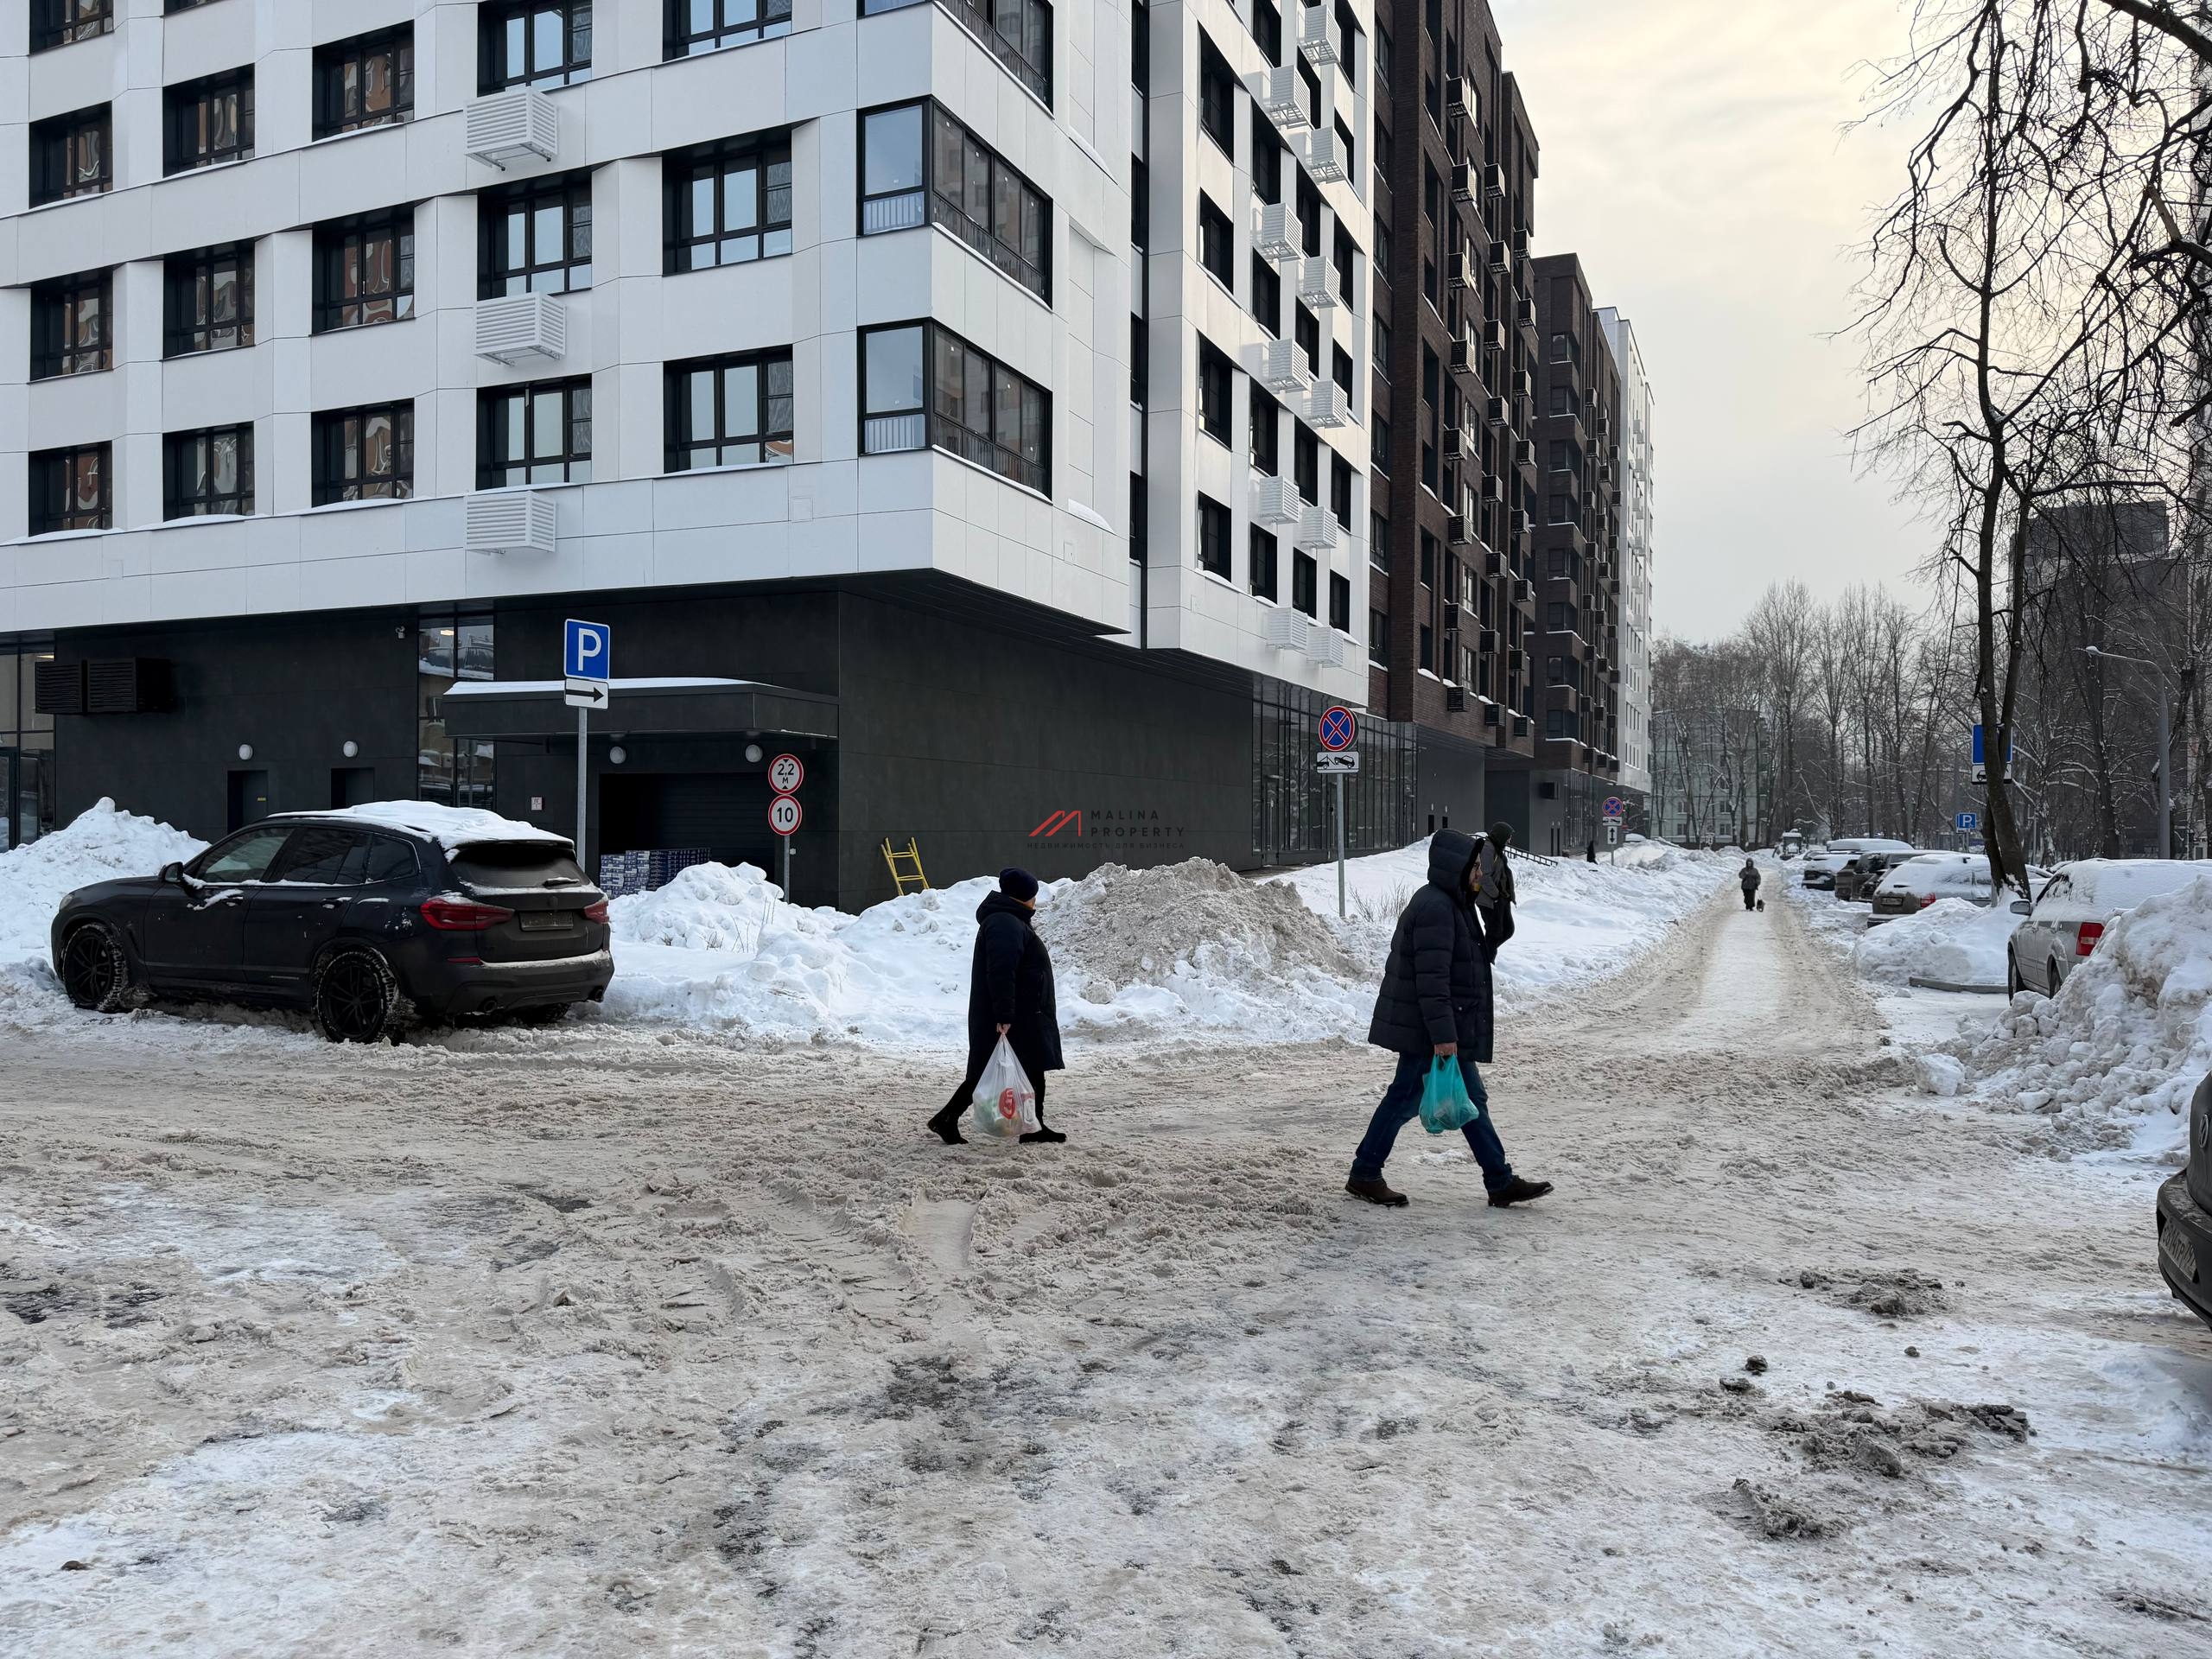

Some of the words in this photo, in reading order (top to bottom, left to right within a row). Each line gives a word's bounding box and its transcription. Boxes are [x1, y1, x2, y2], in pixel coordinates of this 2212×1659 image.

[578, 628, 602, 671] P
[778, 764, 794, 777] 2,2
[778, 807, 793, 823] 10
[1962, 815, 1973, 828] P
